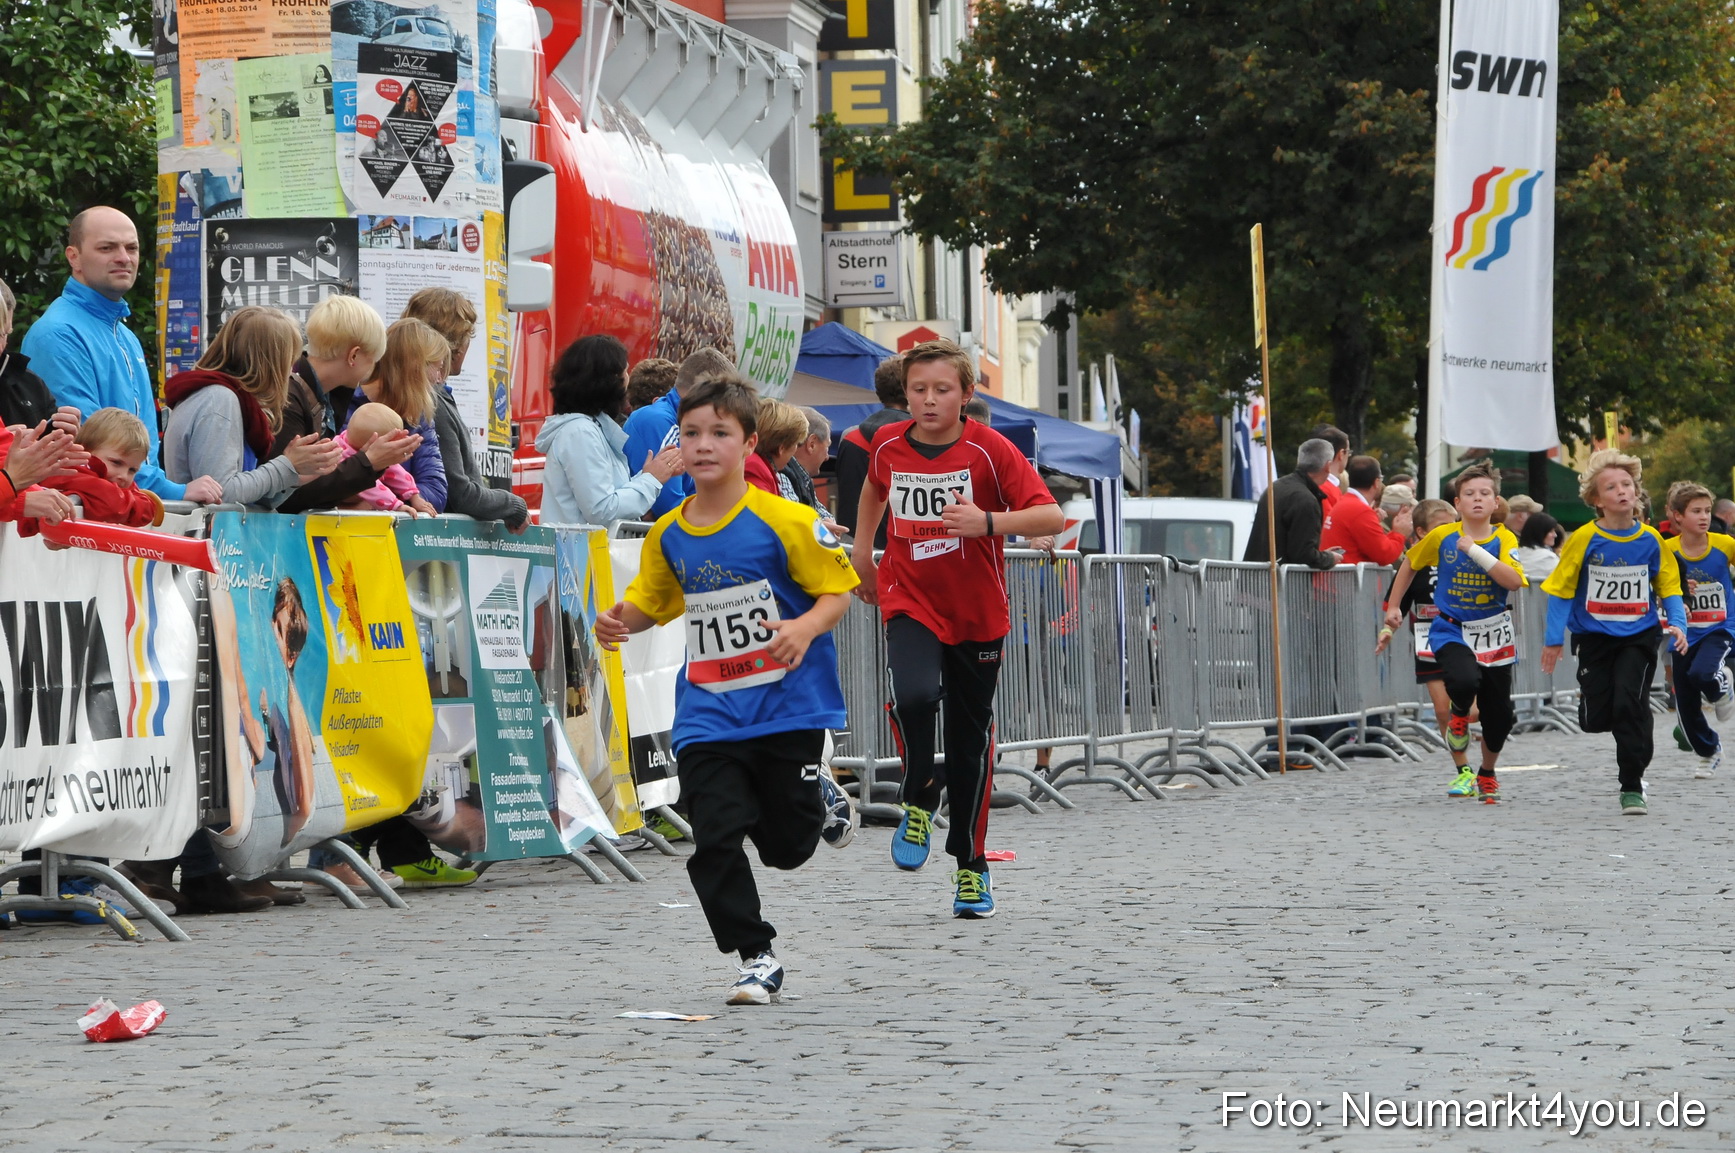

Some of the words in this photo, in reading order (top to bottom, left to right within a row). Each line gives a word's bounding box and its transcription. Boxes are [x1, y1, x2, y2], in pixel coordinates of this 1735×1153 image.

[216, 5, 257, 13] 18.05.2014
[393, 54, 428, 71] JAZZ
[1451, 50, 1547, 98] swn
[171, 220, 200, 232] Stadtlauf
[231, 243, 254, 251] WORLD
[254, 242, 285, 250] FAMOUS
[829, 235, 896, 248] Altstadthotel
[744, 203, 799, 298] AVIA
[220, 255, 340, 284] GLENN
[358, 260, 434, 271] Sonntagsführungen
[435, 263, 446, 271] für
[447, 264, 481, 273] Jedermann
[838, 253, 888, 269] Stern
[840, 279, 867, 288] Eingang
[737, 301, 796, 386] Pellets
[1490, 359, 1548, 373] neumarkt
[915, 475, 957, 484] Neumarkt
[896, 485, 965, 517] 7067
[413, 533, 425, 547] Seit
[924, 541, 947, 554] DEHN
[107, 542, 134, 556] BKK
[136, 546, 165, 560] Audi
[1590, 569, 1609, 578] PARTL
[1611, 571, 1639, 579] Neumarkt
[1594, 579, 1641, 600] 7201
[706, 594, 756, 613] Neumarkt
[1598, 605, 1637, 613] Jonathan
[690, 607, 774, 655] 7153
[1469, 625, 1512, 651] 7175
[719, 659, 754, 678] Elias
[332, 687, 362, 705] Pflaster
[327, 714, 384, 734] Außenplatten
[63, 755, 171, 814] neumarkt
[494, 809, 522, 826] Komplette
[508, 826, 546, 844] Designdecken
